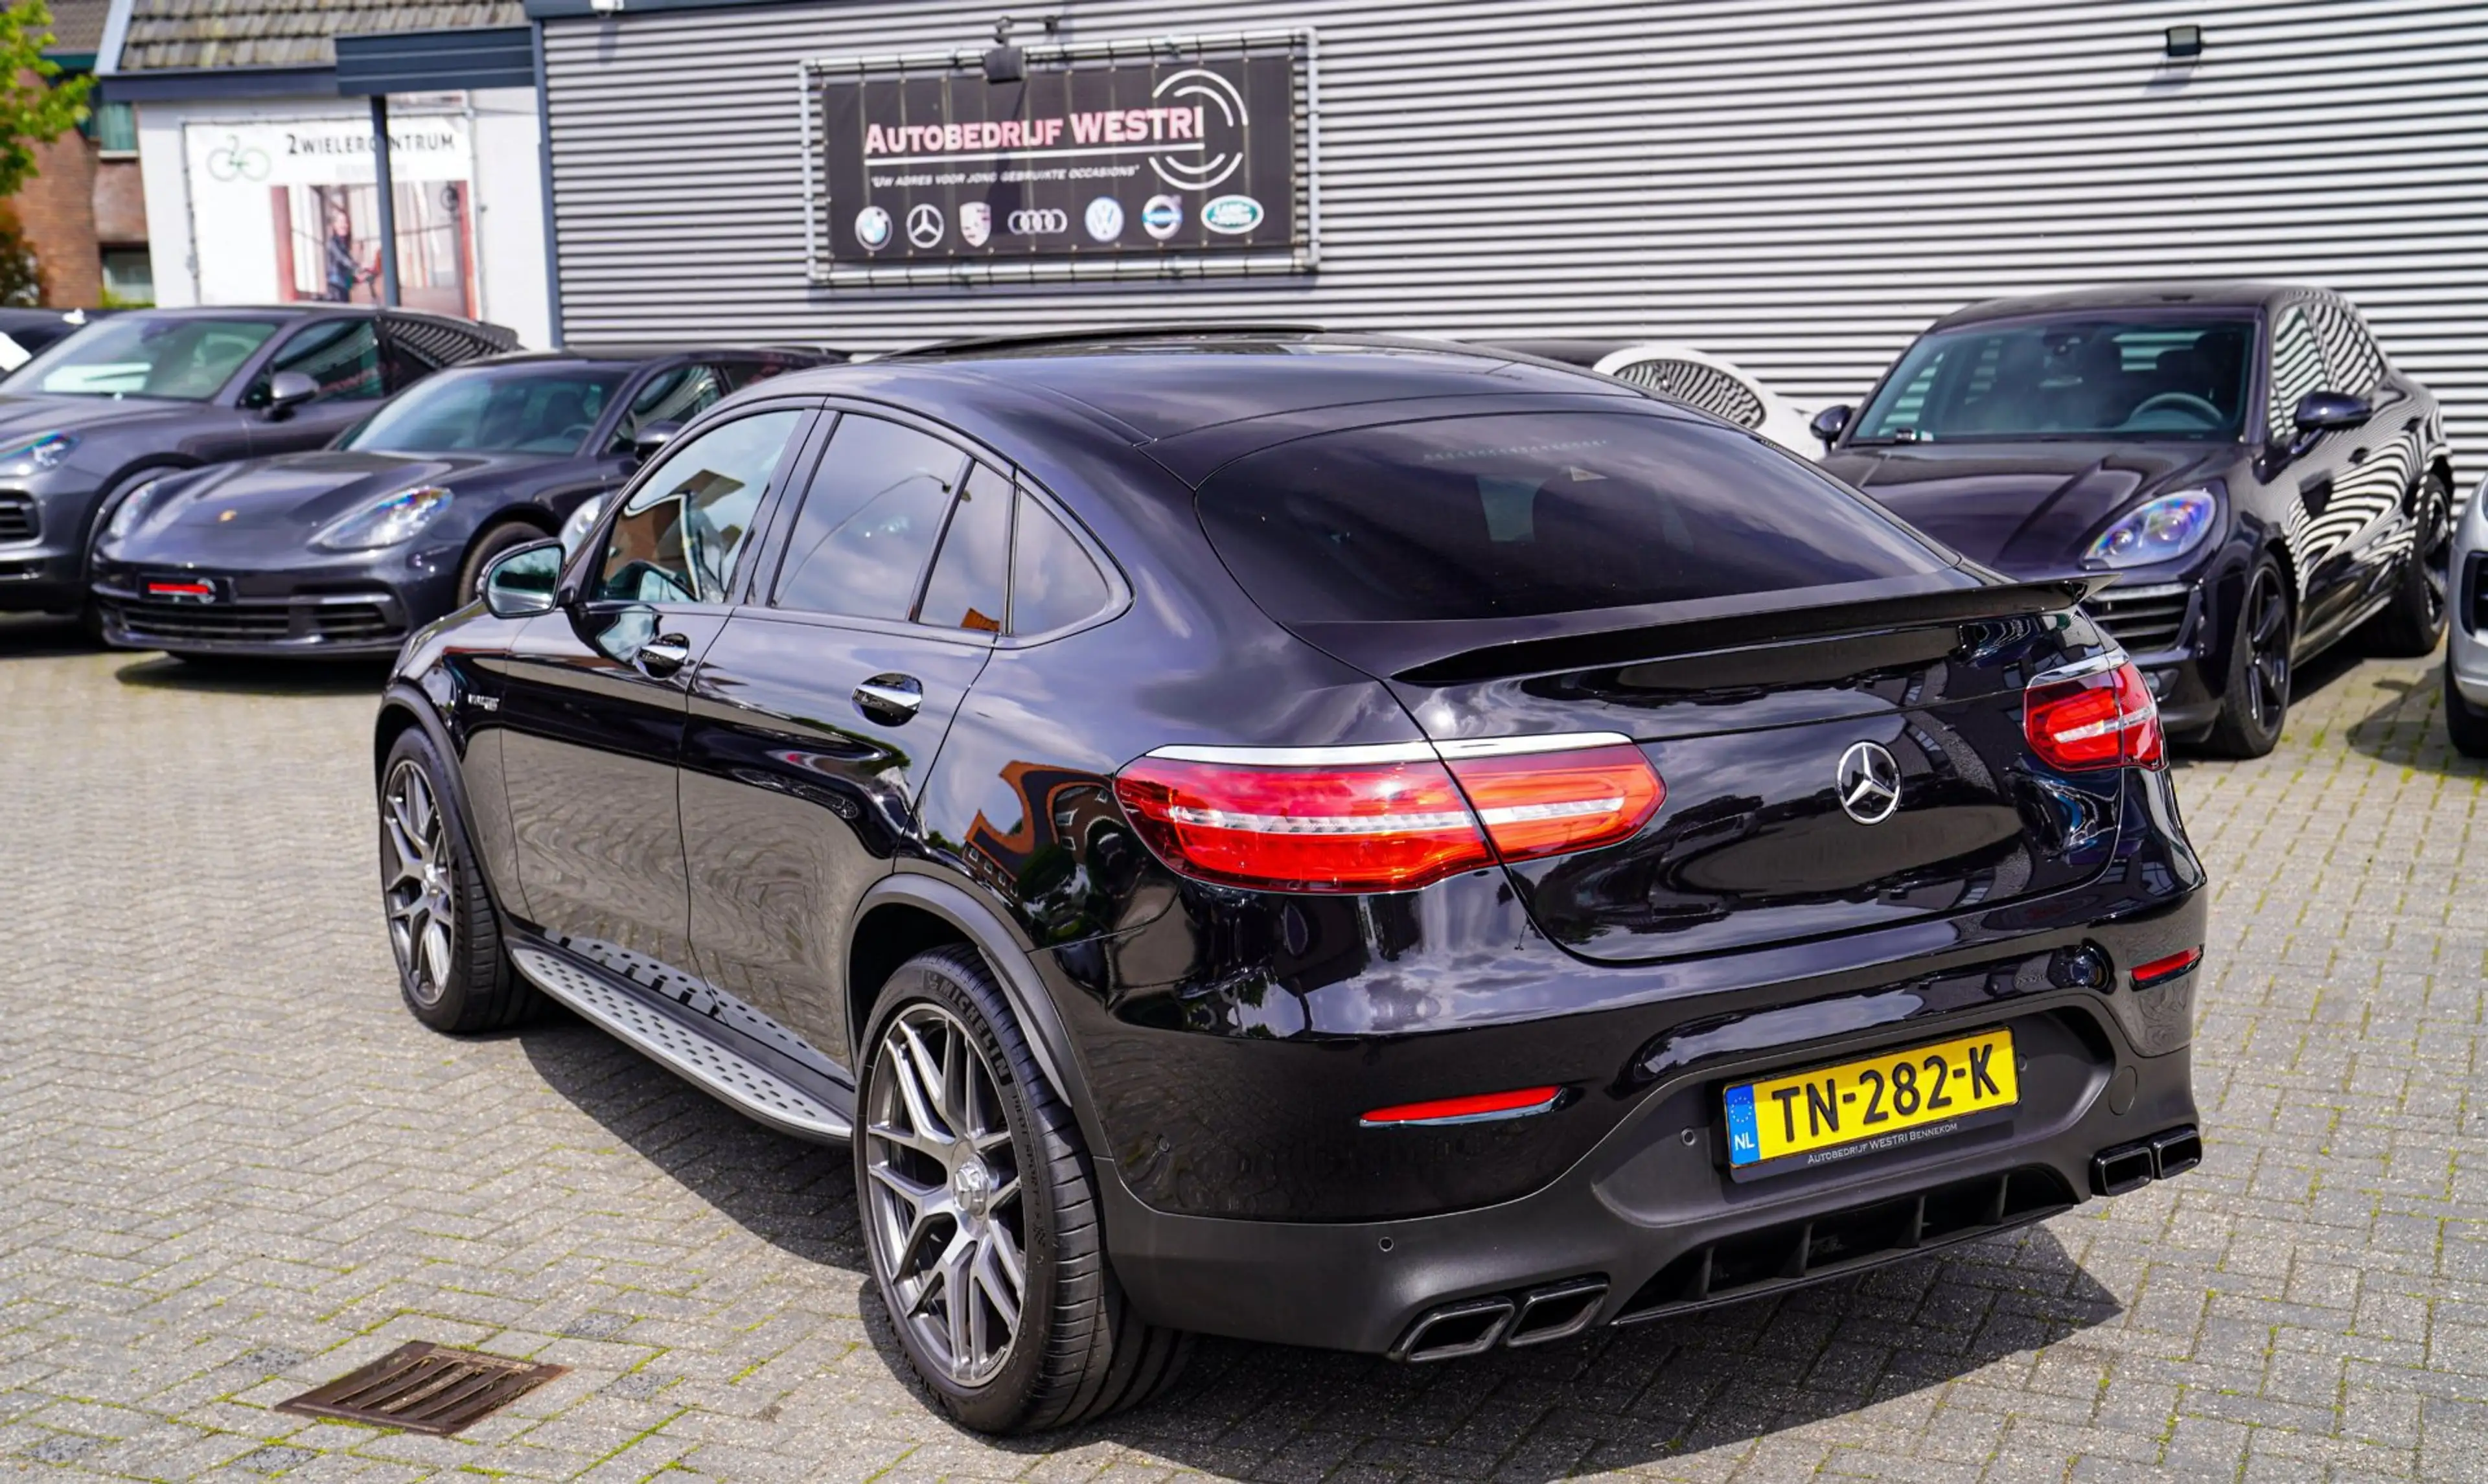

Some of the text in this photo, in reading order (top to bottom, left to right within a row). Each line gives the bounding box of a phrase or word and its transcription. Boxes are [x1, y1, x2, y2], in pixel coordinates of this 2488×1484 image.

[864, 106, 1204, 154] AUTOBEDRIJF WESTRI
[939, 980, 1010, 1078] MICHELIN
[1771, 1044, 2000, 1143] TN-282-K
[1734, 1132, 1755, 1151] NL
[1808, 1123, 1957, 1164] AUTOBEDRIJF WESTRI BENNEKOM
